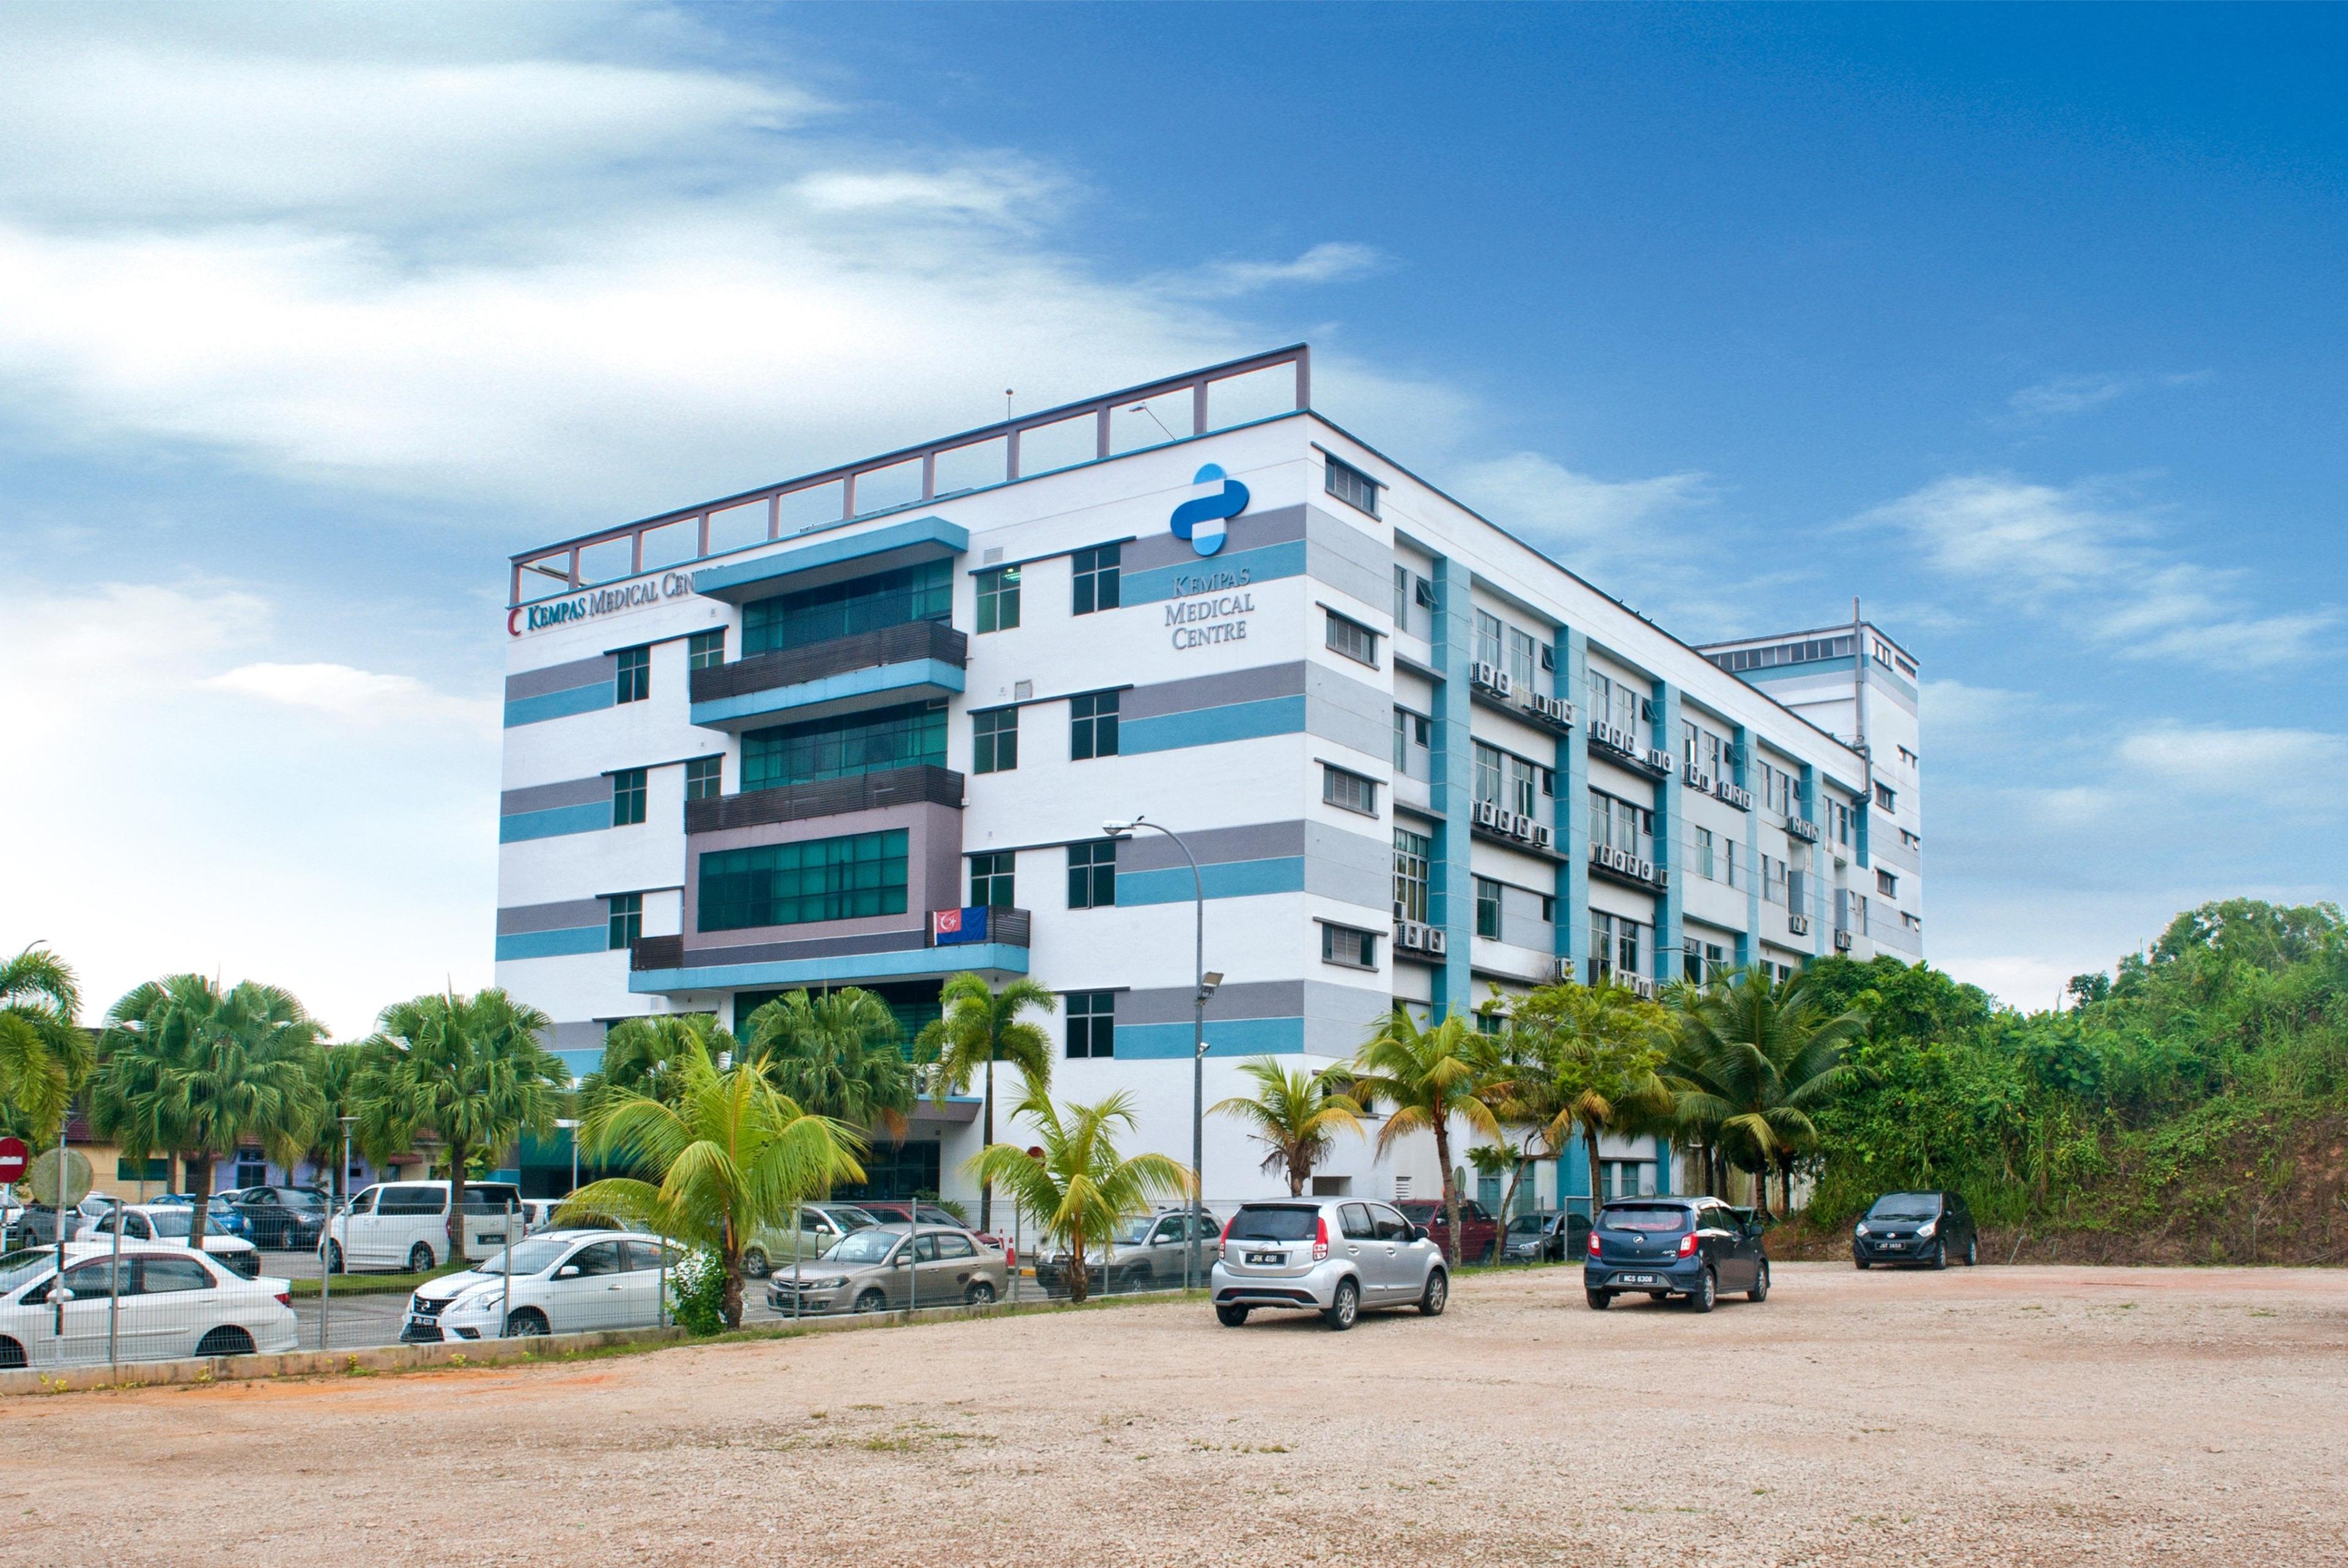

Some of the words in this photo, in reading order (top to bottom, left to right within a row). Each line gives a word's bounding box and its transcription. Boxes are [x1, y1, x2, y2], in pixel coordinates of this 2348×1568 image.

[1172, 568, 1250, 598] KEMPAS
[528, 597, 586, 630] KEMPAS
[588, 581, 659, 616] MEDICAL
[1165, 594, 1255, 626] MEDICAL
[1172, 620, 1246, 650] CENTRE
